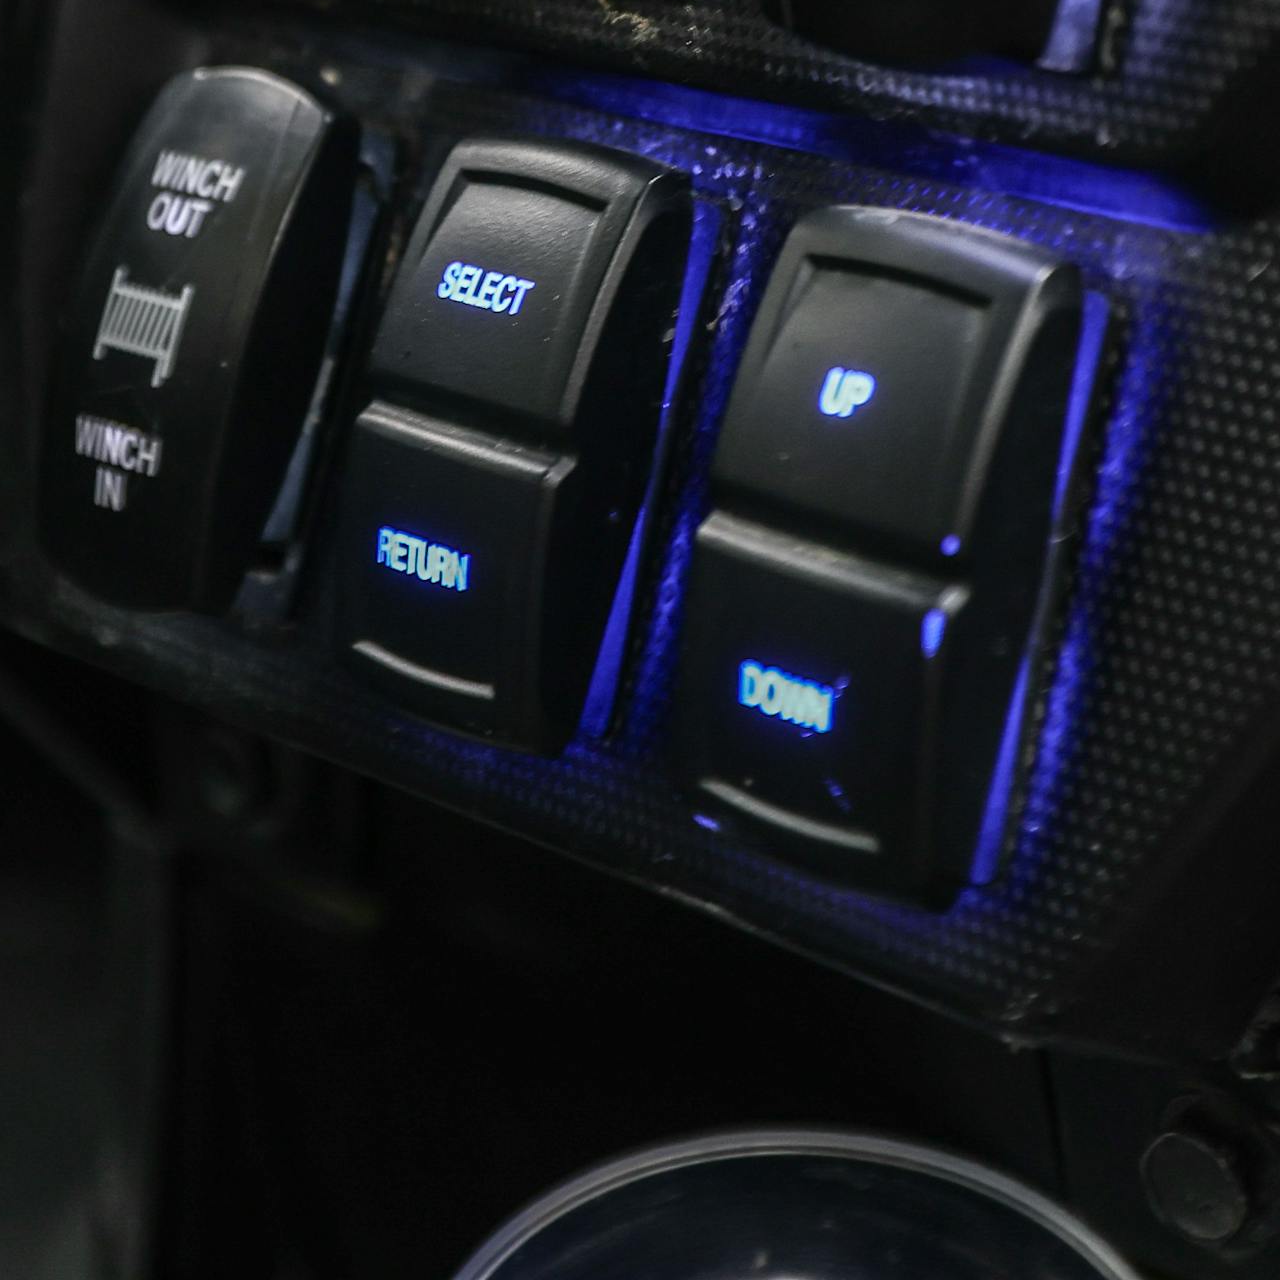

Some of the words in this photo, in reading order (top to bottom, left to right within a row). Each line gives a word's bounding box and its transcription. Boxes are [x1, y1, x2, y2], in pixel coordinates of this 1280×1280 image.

[152, 151, 243, 201] WINCH
[148, 198, 212, 237] OUT
[438, 261, 535, 314] SELECT
[819, 367, 875, 417] UP
[75, 416, 161, 476] WINCH
[94, 469, 127, 511] IN
[377, 527, 469, 591] RETURN
[739, 660, 833, 732] DOWN
